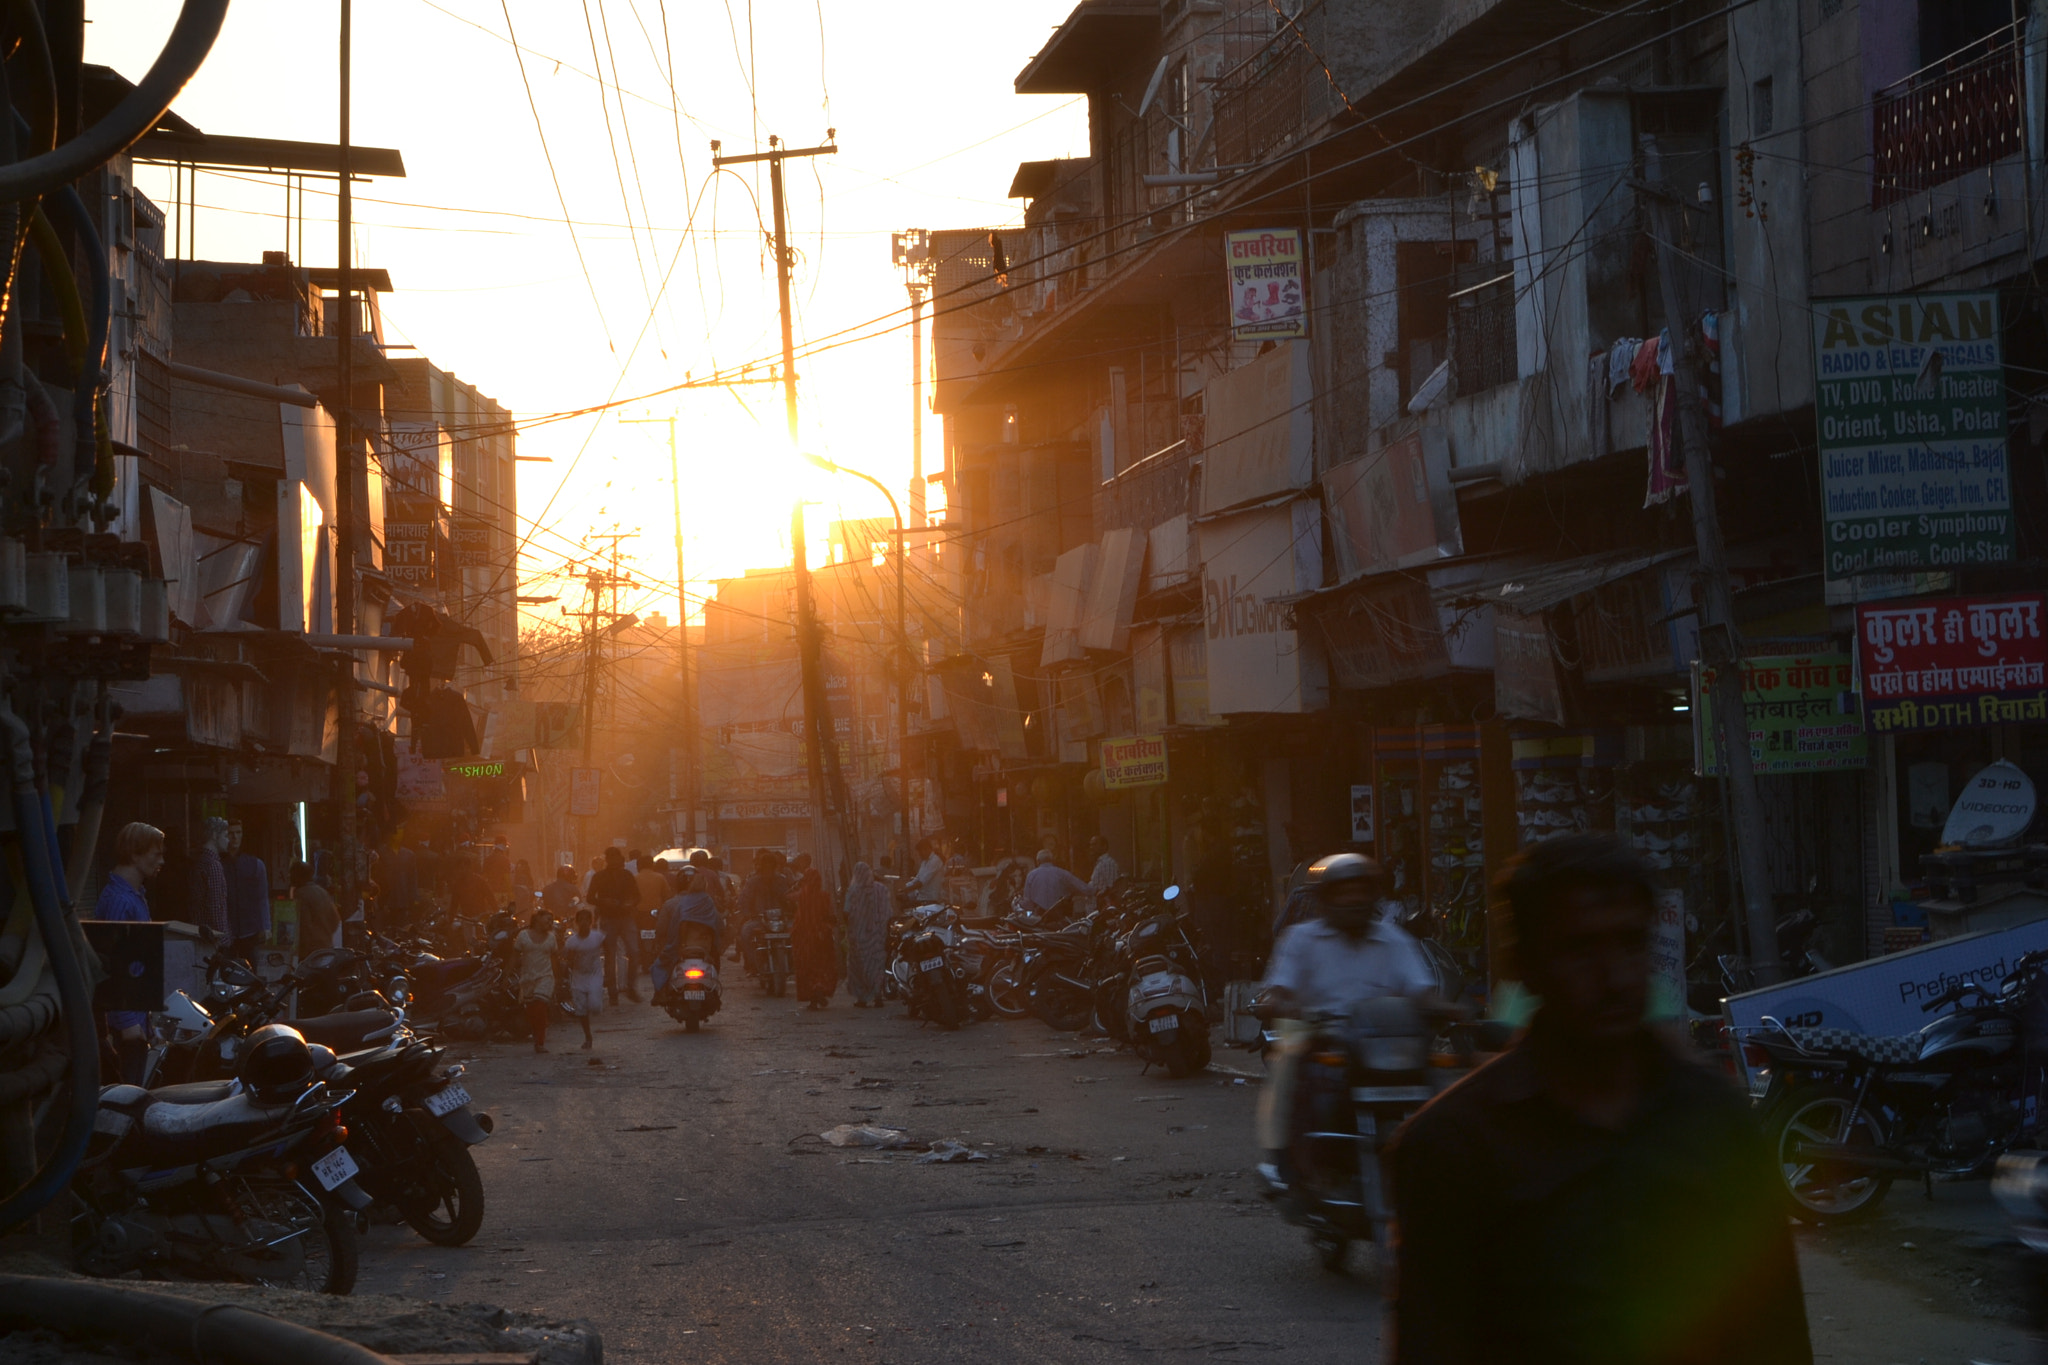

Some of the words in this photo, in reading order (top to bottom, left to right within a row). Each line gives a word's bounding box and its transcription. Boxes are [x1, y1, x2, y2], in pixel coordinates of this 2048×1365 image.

[1232, 234, 1296, 258] टाबरिया
[1822, 300, 1992, 348] ASIAN
[1822, 350, 1870, 374] RADIO
[1876, 351, 1887, 369] &
[1892, 344, 1995, 368] ELERICALS
[1821, 383, 1845, 410] TV,
[1850, 379, 1887, 407] DVD,
[1940, 375, 1998, 399] Theater
[1824, 413, 1887, 440] Orient,
[1893, 409, 1946, 436] Usha,
[1952, 407, 2000, 431] Polar
[1827, 454, 1864, 479] Juicer
[1869, 450, 1904, 476] Mixer,
[1908, 446, 1969, 474] Maharaja,
[1973, 444, 2004, 472] Bajaj
[1828, 487, 1877, 512] Induction
[1881, 484, 1918, 510] Cooker,
[1987, 479, 2006, 502] CFL
[1831, 519, 1910, 542] Cooler
[1919, 513, 2007, 538] Symphony
[386, 541, 427, 562] पान
[1832, 548, 1867, 572] Cool
[1864, 607, 1937, 663] कुलर
[1942, 610, 1964, 643] ही
[1967, 600, 2040, 656] कुलर
[1906, 671, 1918, 693] व
[1921, 662, 1953, 691] होम
[1872, 701, 1919, 730] सभी
[1923, 702, 1972, 727] DTH
[1979, 690, 2047, 723] रिचार्ज
[1115, 740, 1162, 760] टाबरिया
[451, 764, 502, 777] SHION
[1978, 779, 1996, 788] 3D
[2003, 780, 2021, 790] HD
[1900, 958, 2006, 1003] Preferred
